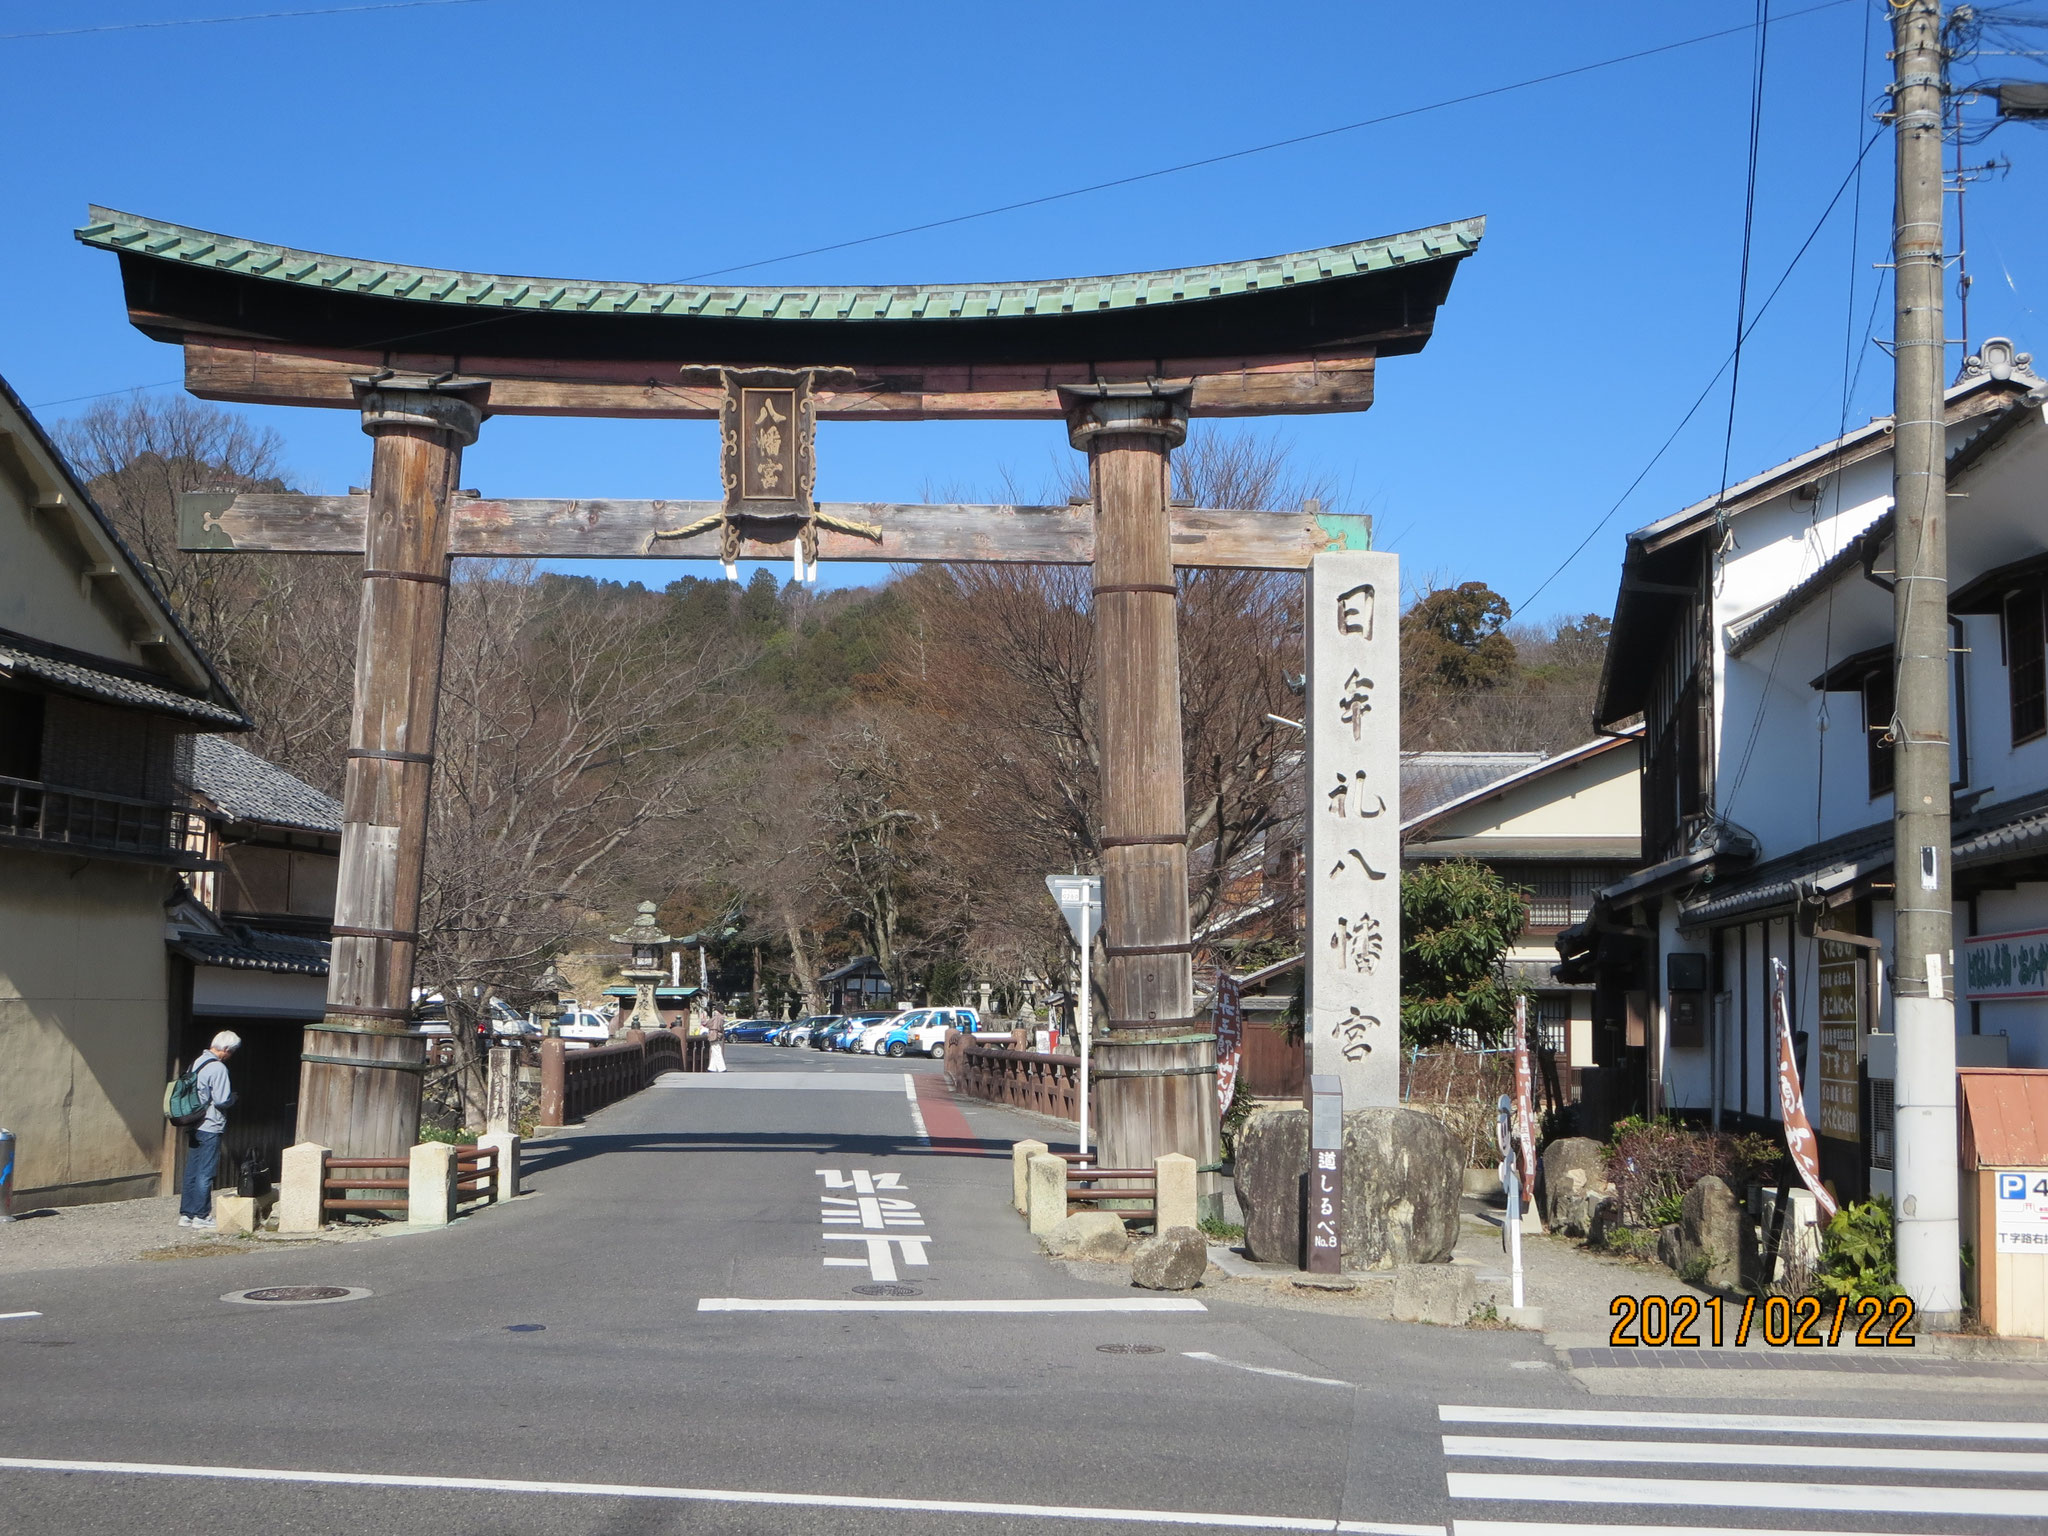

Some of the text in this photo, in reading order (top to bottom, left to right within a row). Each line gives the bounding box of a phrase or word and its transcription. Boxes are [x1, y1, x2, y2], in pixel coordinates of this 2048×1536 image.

[755, 397, 787, 489] 八幡宮
[1328, 583, 1387, 1063] 日牟礼八幡宮
[816, 1169, 933, 1282] 止まれ
[1317, 1151, 1336, 1235] 道しるべ
[1314, 1235, 1338, 1248] No.8
